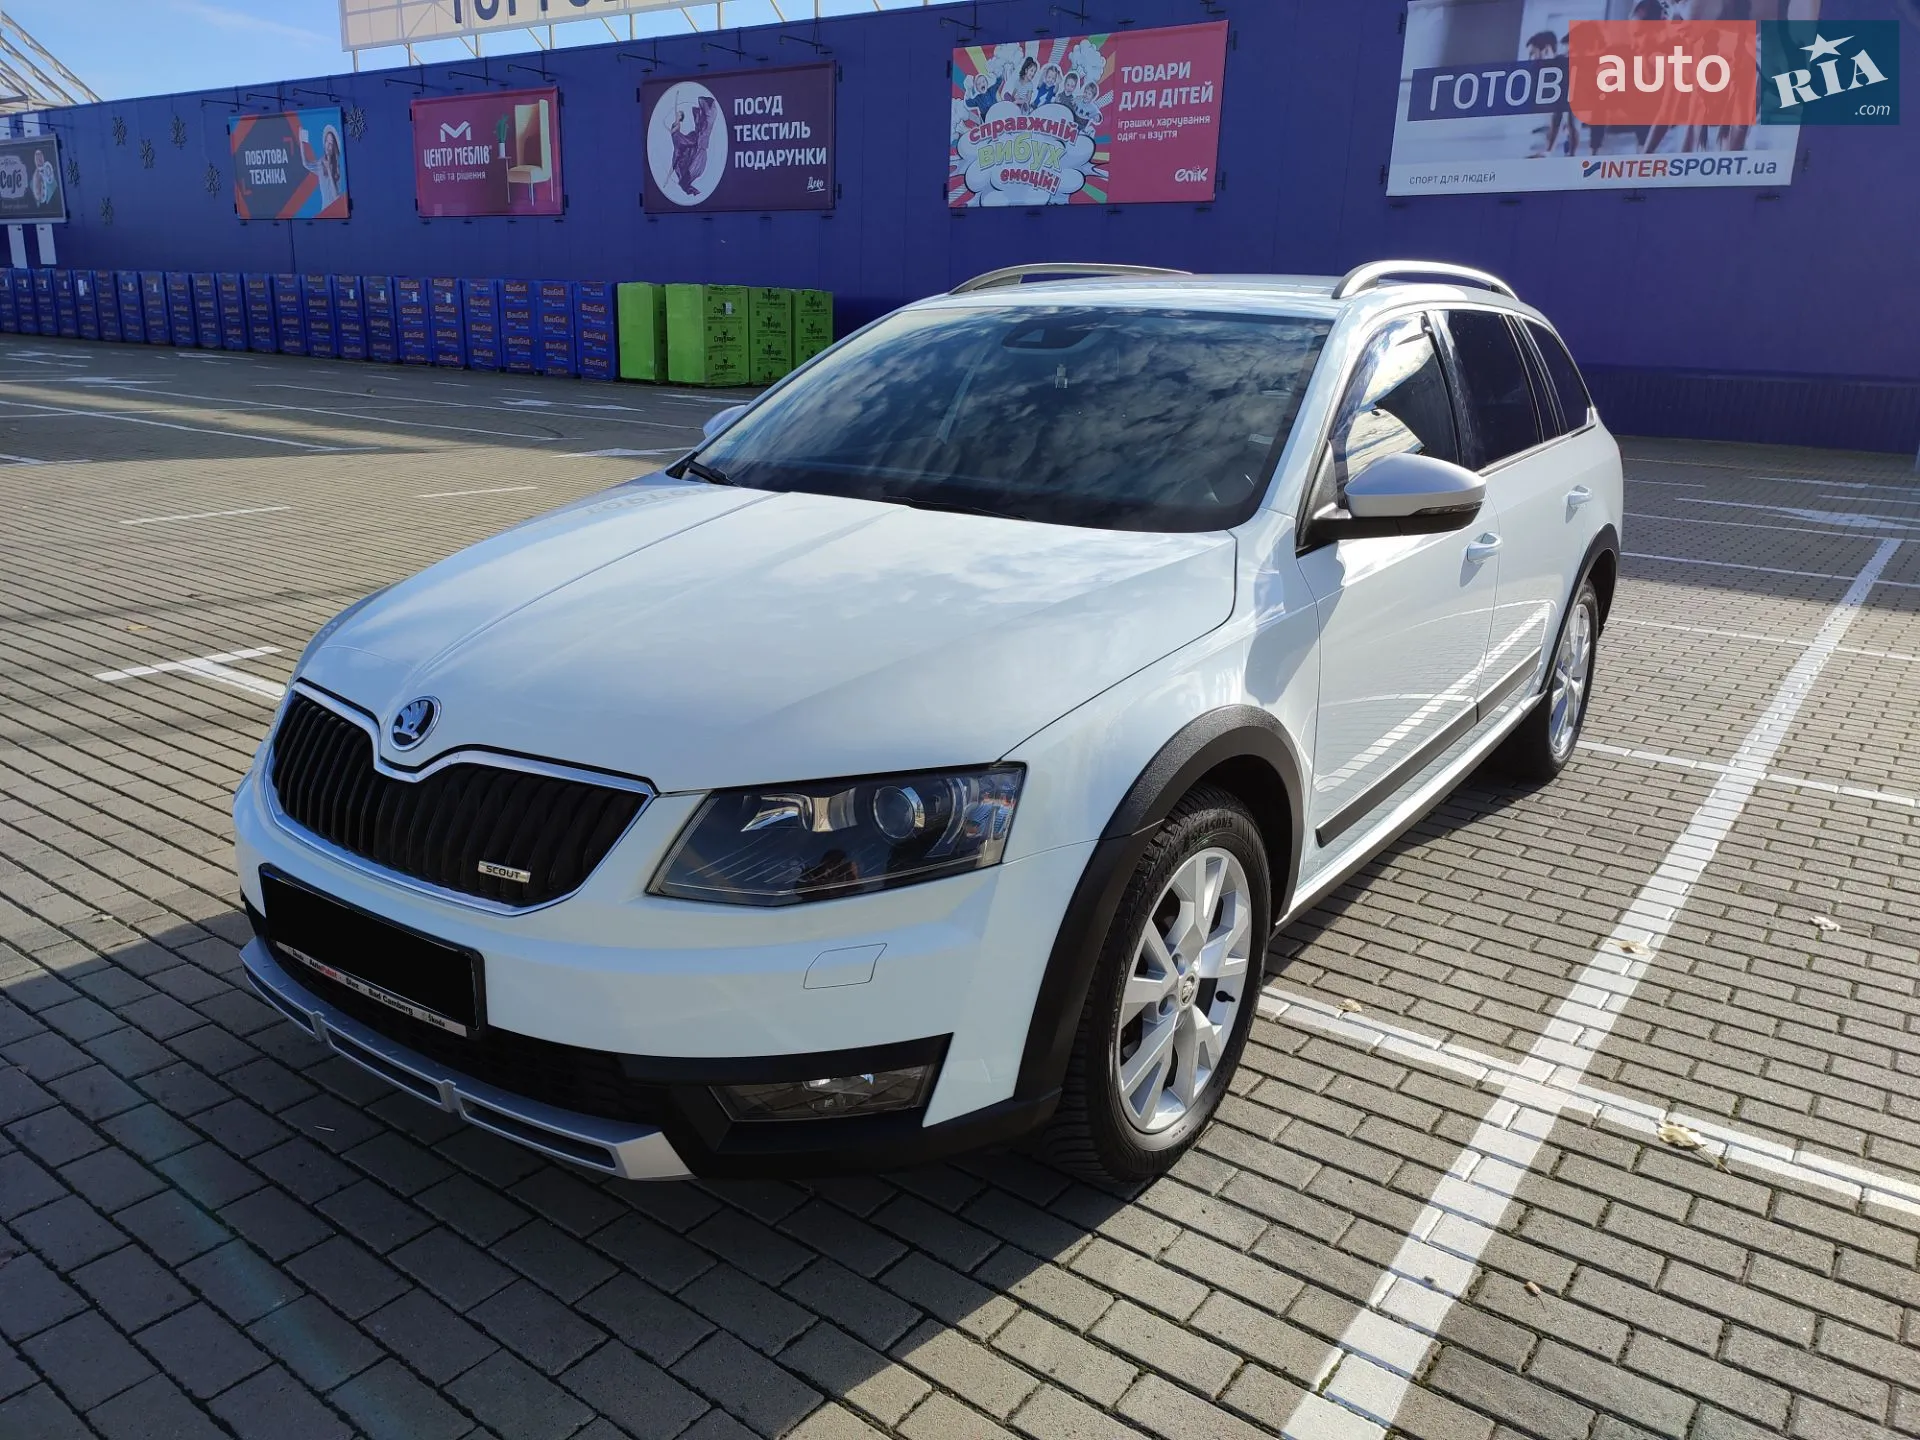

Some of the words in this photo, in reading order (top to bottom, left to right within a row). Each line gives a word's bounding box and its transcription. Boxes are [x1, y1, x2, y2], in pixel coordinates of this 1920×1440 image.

[1121, 61, 1191, 84] ТОВАРИ
[734, 95, 783, 116] ПОСУД
[1118, 90, 1156, 112] ДЛЯ
[1159, 80, 1214, 108] ДІТЕЙ
[734, 121, 811, 142] ТЕКСТИЛЬ
[968, 116, 1078, 144] справжній
[1156, 116, 1210, 128] харчування
[245, 149, 288, 166] ПОБУТОВА
[424, 148, 453, 170] ЦЕНТР
[735, 147, 827, 170] ПОДАРУНКИ
[978, 133, 1066, 172] вибух
[250, 168, 287, 184] ТЕХНІКА
[1409, 176, 1438, 184] СПОРТ
[1440, 175, 1459, 184] ДЛЯ
[486, 865, 521, 879] SCOUT
